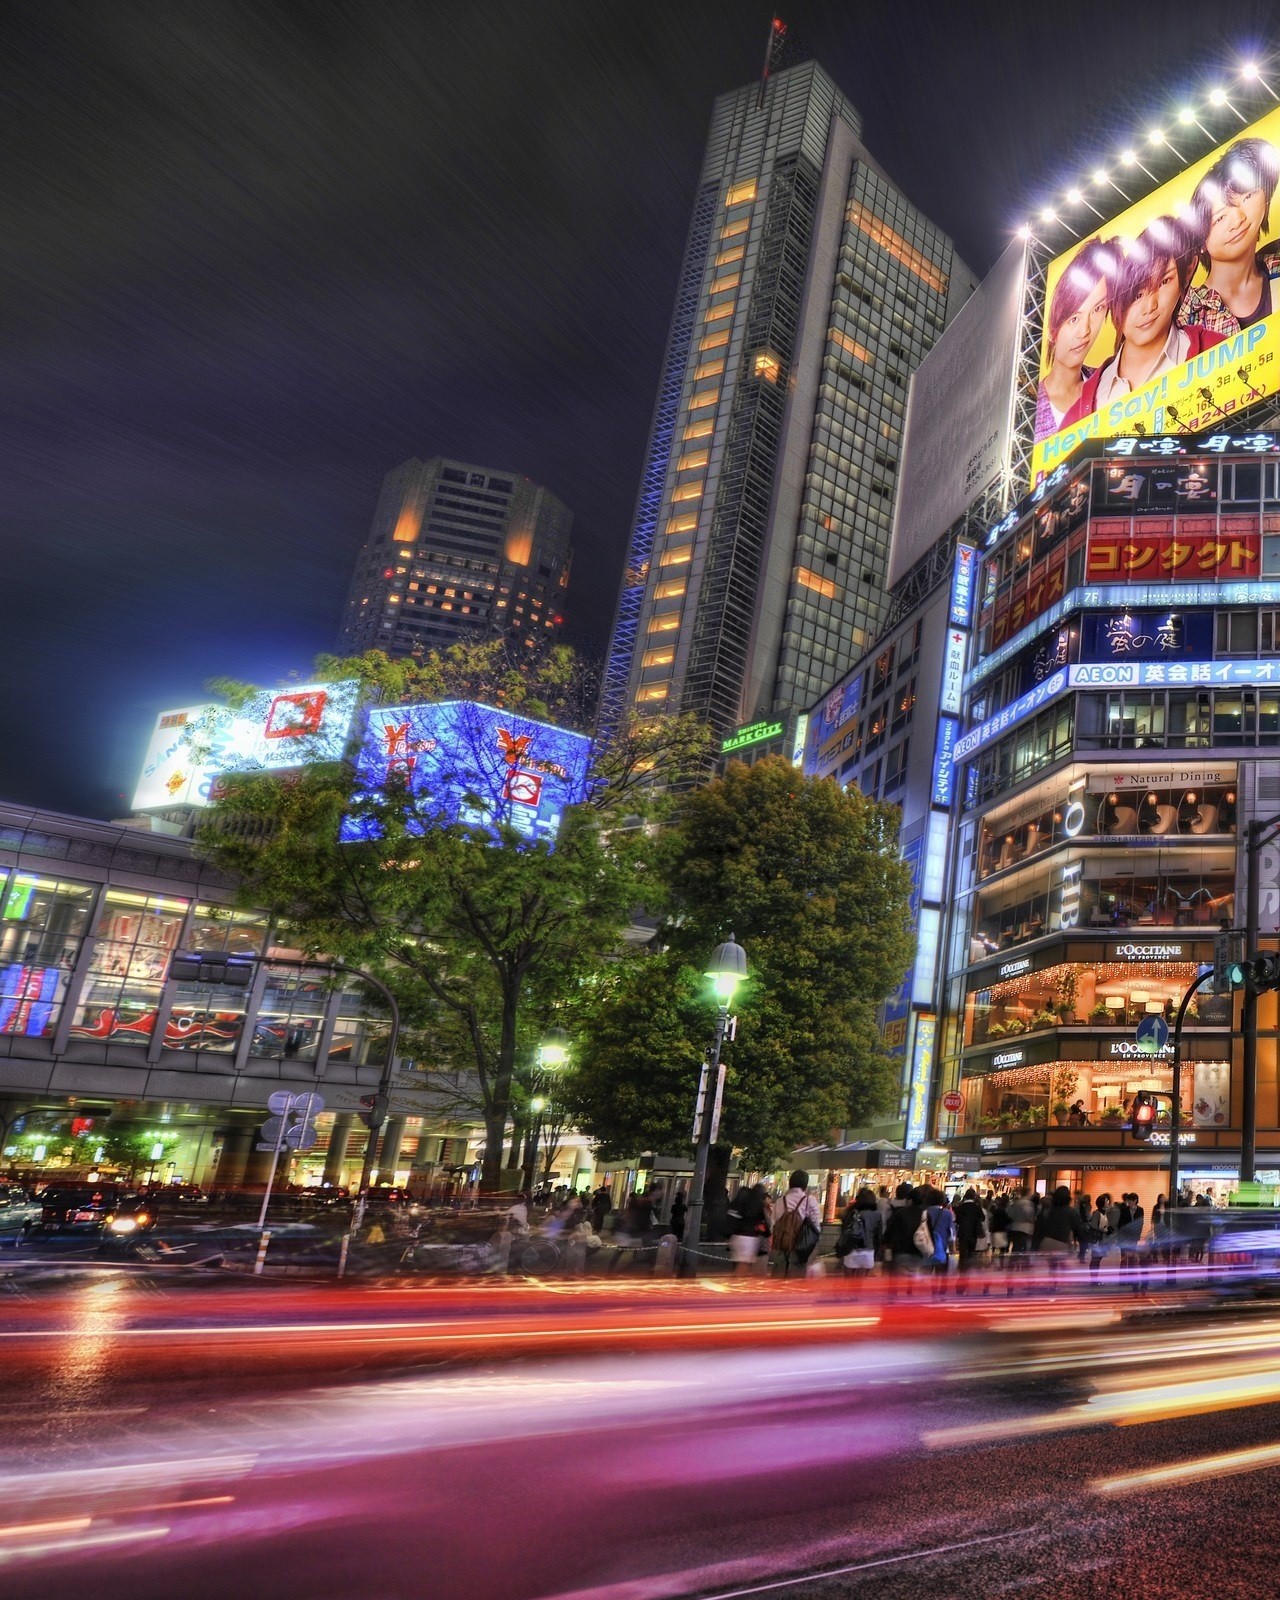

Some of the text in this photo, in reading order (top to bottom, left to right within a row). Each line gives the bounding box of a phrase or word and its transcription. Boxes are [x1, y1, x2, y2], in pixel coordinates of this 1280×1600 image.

[1043, 413, 1101, 463] Hey!
[1108, 376, 1168, 427] Say!
[1178, 324, 1268, 389] JUMP
[1110, 469, 1125, 478] 9F
[1090, 541, 1257, 571] コンタクト
[994, 567, 1064, 643] プライス
[1084, 592, 1099, 602] 7F
[1076, 666, 1134, 683] AEON
[722, 721, 782, 750] MARK CITY
[737, 721, 768, 736] SHIBUYA
[954, 731, 981, 758] AEON
[1130, 772, 1221, 783] Natural Dining
[935, 794, 948, 804] 5F
[1115, 944, 1182, 956] L'OCCITANE
